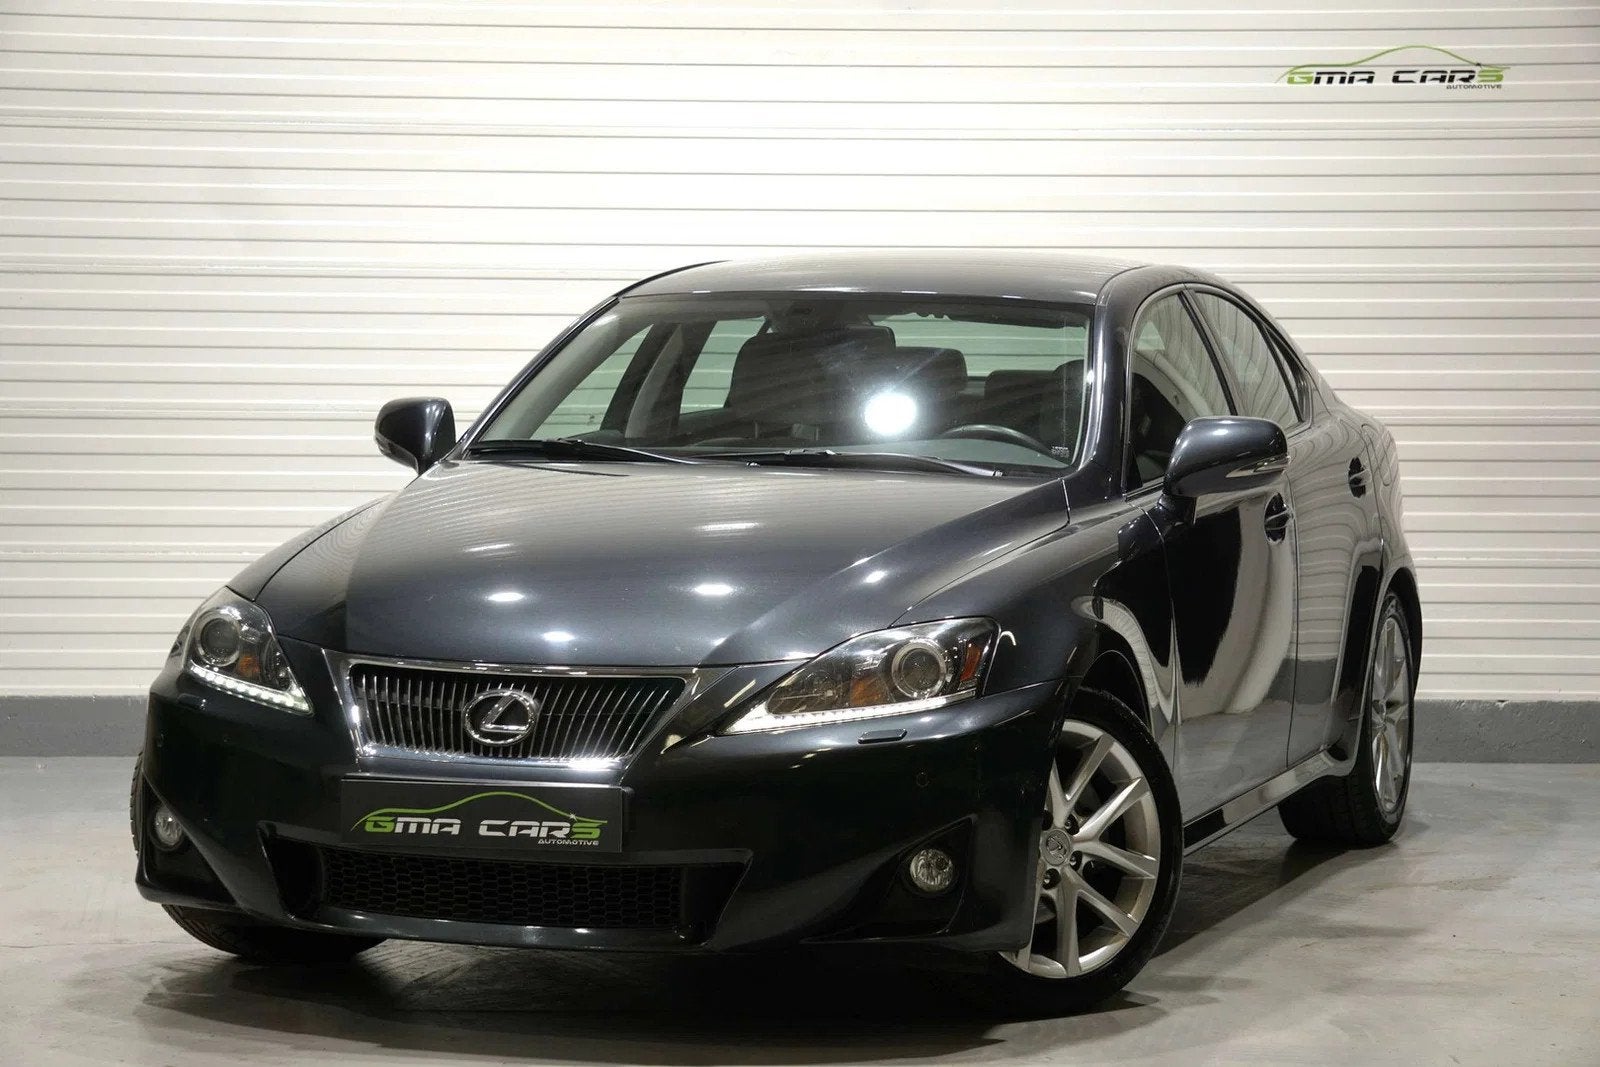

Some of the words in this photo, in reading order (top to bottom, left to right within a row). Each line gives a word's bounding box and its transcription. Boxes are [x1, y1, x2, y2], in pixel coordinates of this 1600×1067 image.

[1287, 71, 1375, 84] GMA
[1392, 69, 1504, 84] CARS
[365, 816, 461, 835] GMA
[478, 819, 602, 839] CARS
[537, 838, 599, 846] AUTOMOTIVE
